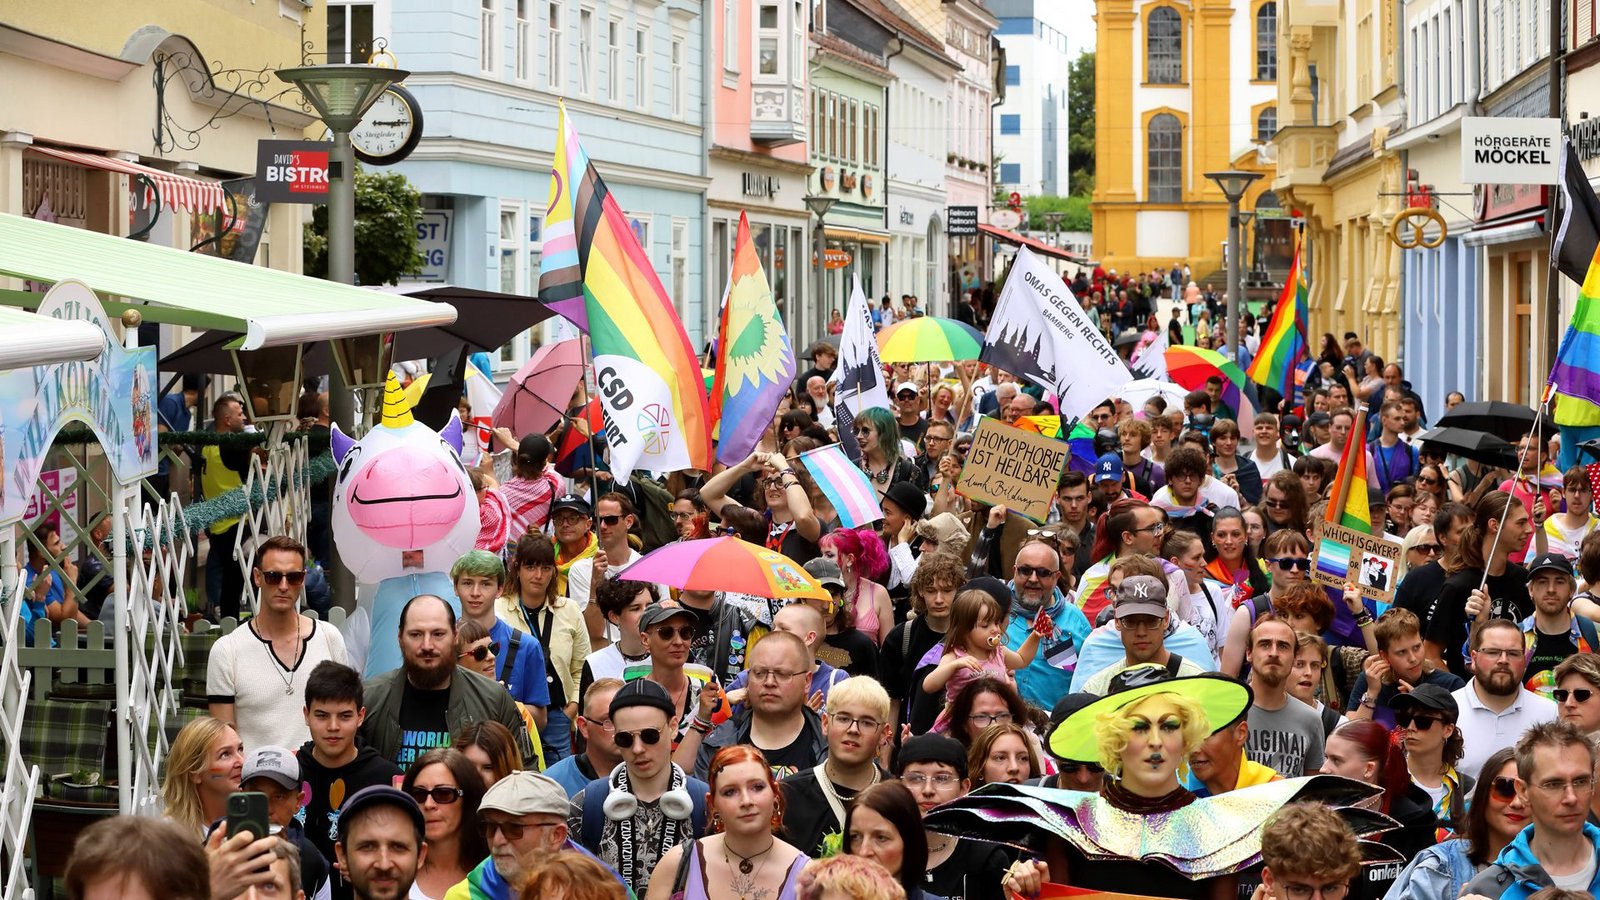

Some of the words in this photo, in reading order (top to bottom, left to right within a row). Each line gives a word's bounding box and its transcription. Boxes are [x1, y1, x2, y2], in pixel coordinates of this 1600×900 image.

[1474, 134, 1551, 148] HÖRGERÄTE
[274, 153, 300, 165] DAVID'S
[1474, 147, 1551, 165] MÖCKEL
[1024, 271, 1052, 297] OMAS
[1049, 295, 1083, 328] GEGEN
[1080, 326, 1119, 366] RECHTS
[1042, 308, 1075, 340] BAMBERG
[598, 366, 634, 411] CSD
[600, 401, 628, 448] FURT
[971, 448, 994, 468] IST
[977, 429, 1065, 472] HOMOPHOBIE
[1102, 461, 1112, 471] NY
[1322, 524, 1355, 545] WHICH
[1355, 536, 1364, 549] IS
[1365, 540, 1399, 559] GAYER?
[1349, 560, 1359, 570] OR
[1315, 571, 1333, 583] BEING
[1133, 582, 1148, 598] NY
[1362, 586, 1377, 597] THIS
[402, 730, 451, 748] WORLD
[1245, 729, 1305, 758] RIGINAL
